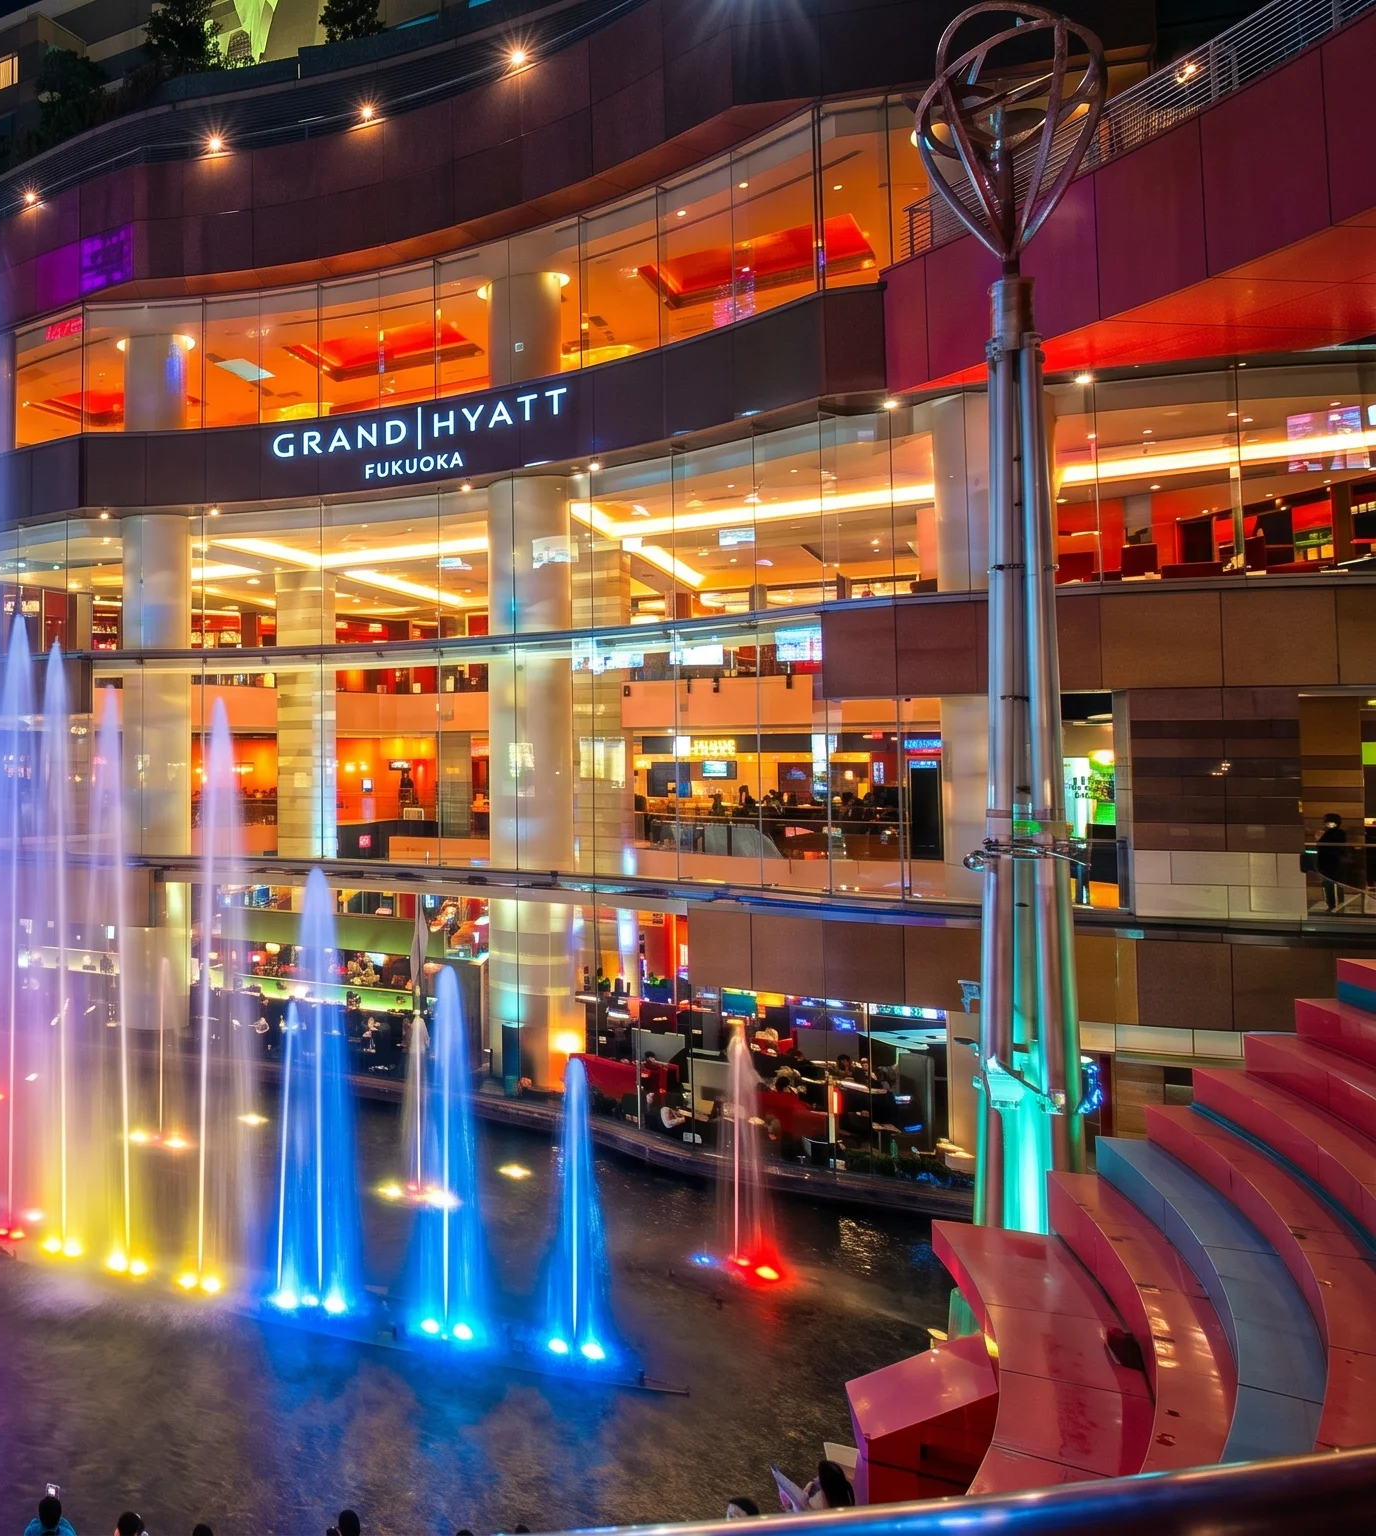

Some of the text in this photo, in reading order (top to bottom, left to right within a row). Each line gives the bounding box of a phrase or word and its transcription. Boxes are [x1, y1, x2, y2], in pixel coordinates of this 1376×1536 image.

[272, 387, 567, 458] GRAND HYATT
[365, 451, 464, 479] FUKUOKA
